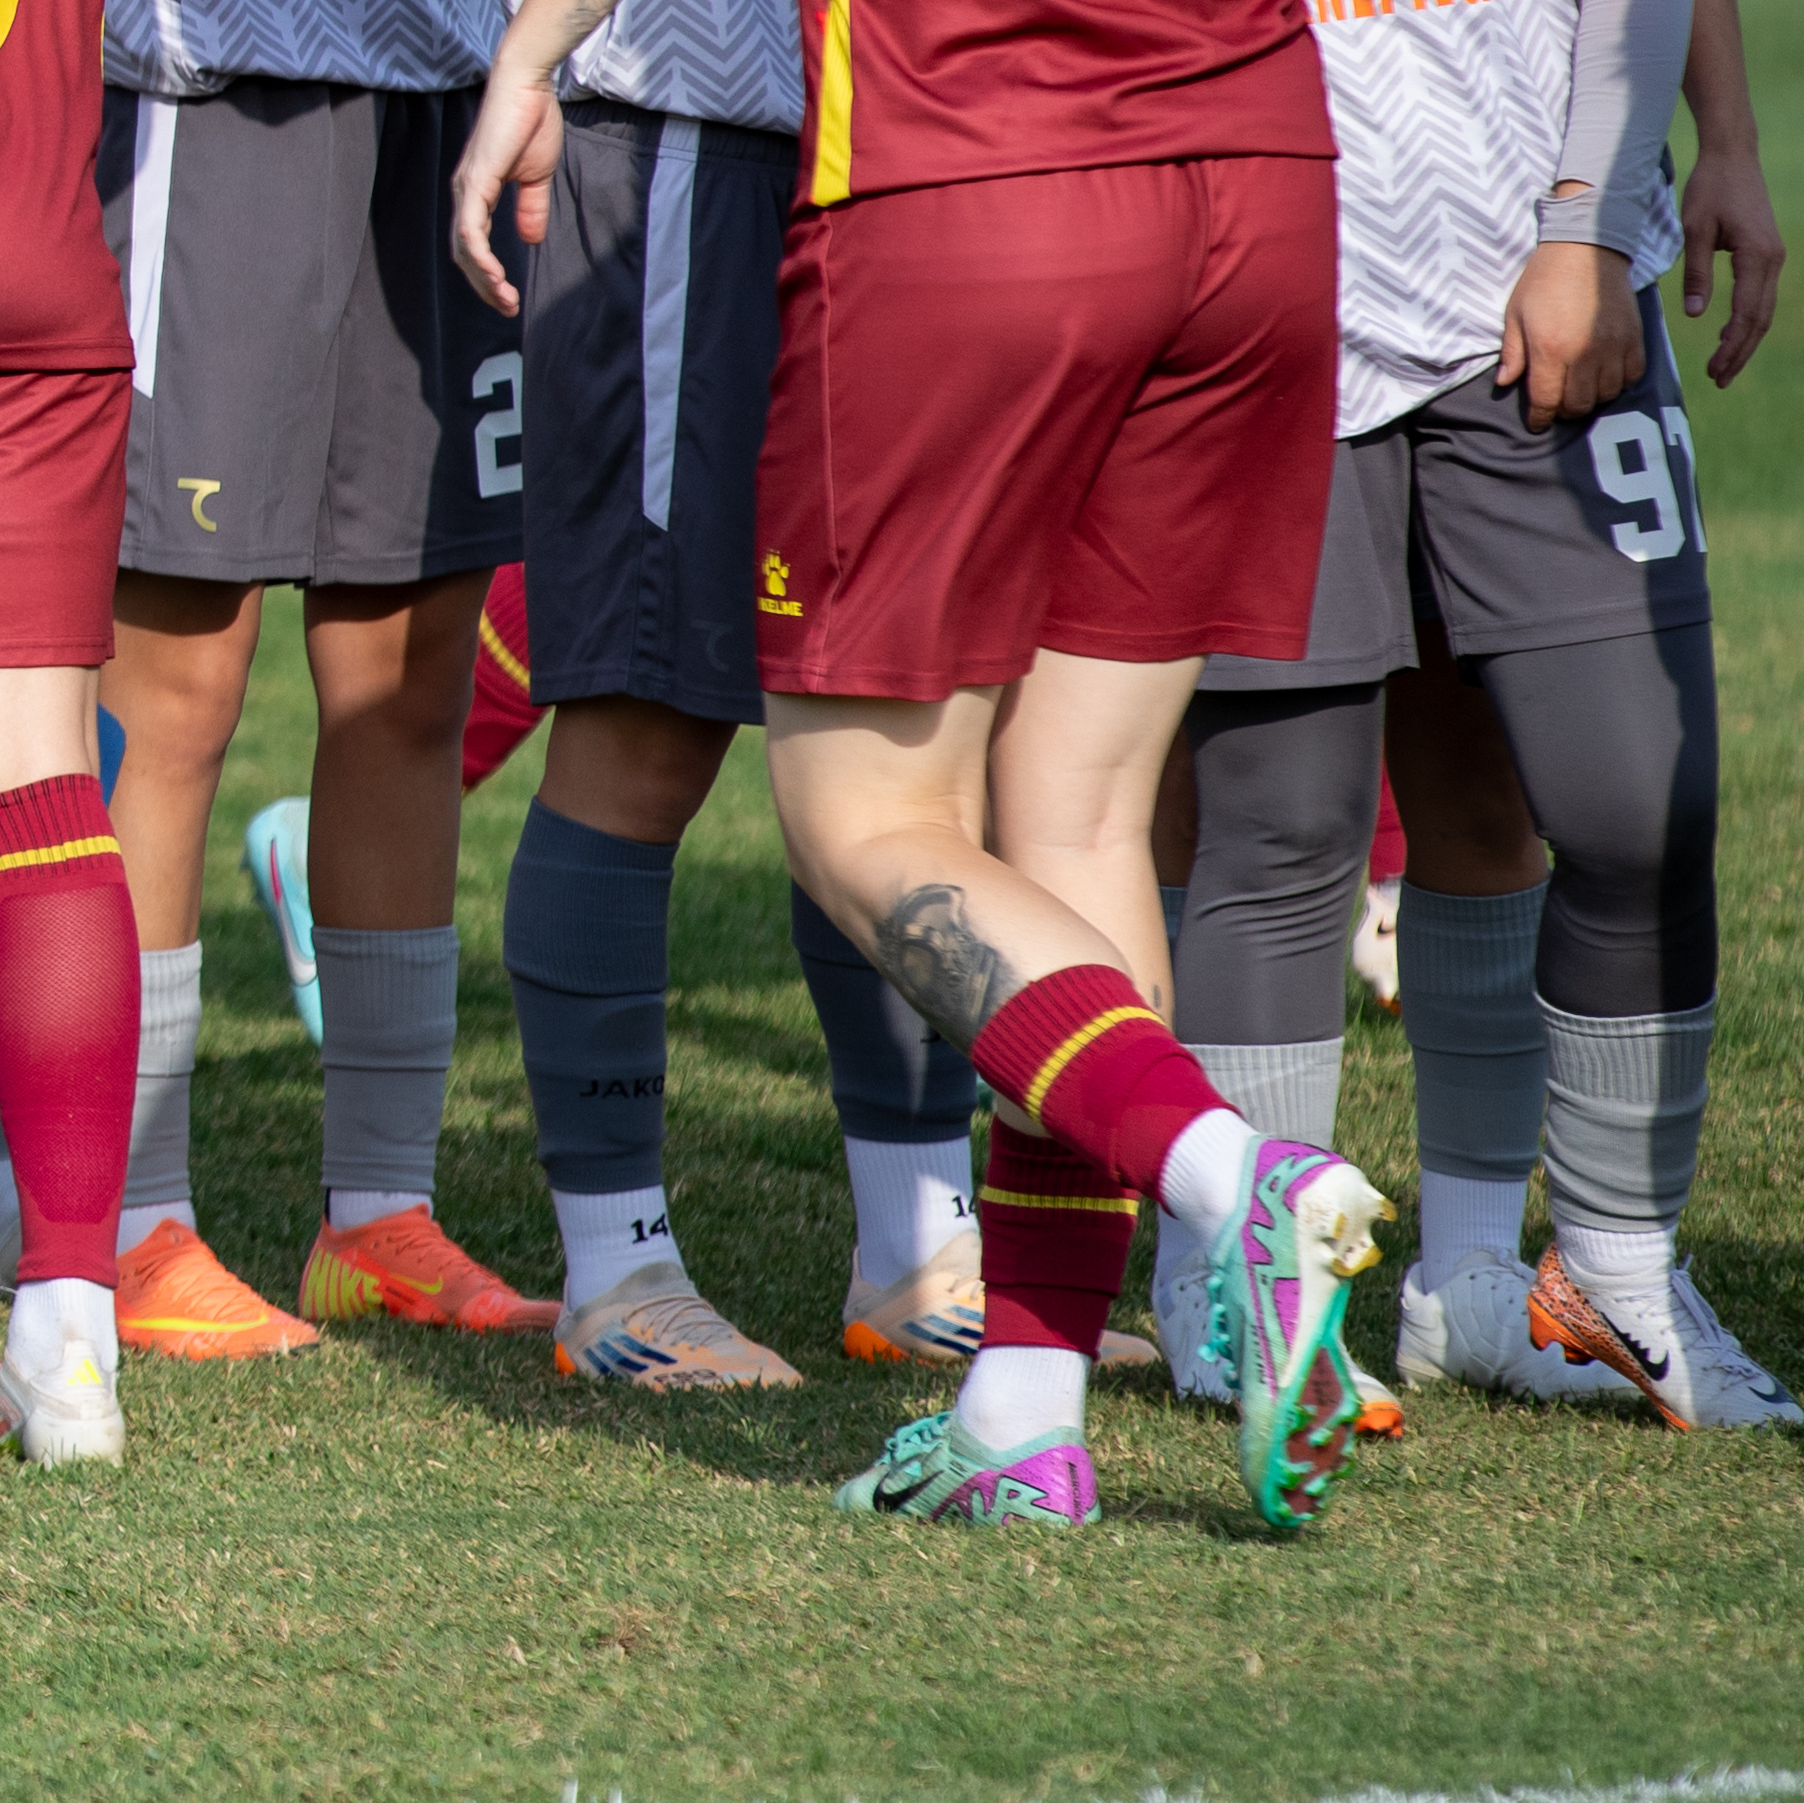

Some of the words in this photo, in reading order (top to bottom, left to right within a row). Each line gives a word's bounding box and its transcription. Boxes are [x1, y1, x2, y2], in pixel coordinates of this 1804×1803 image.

[579, 1074, 665, 1100] JAKO
[630, 1212, 669, 1245] 14
[301, 1247, 383, 1320] NIKE
